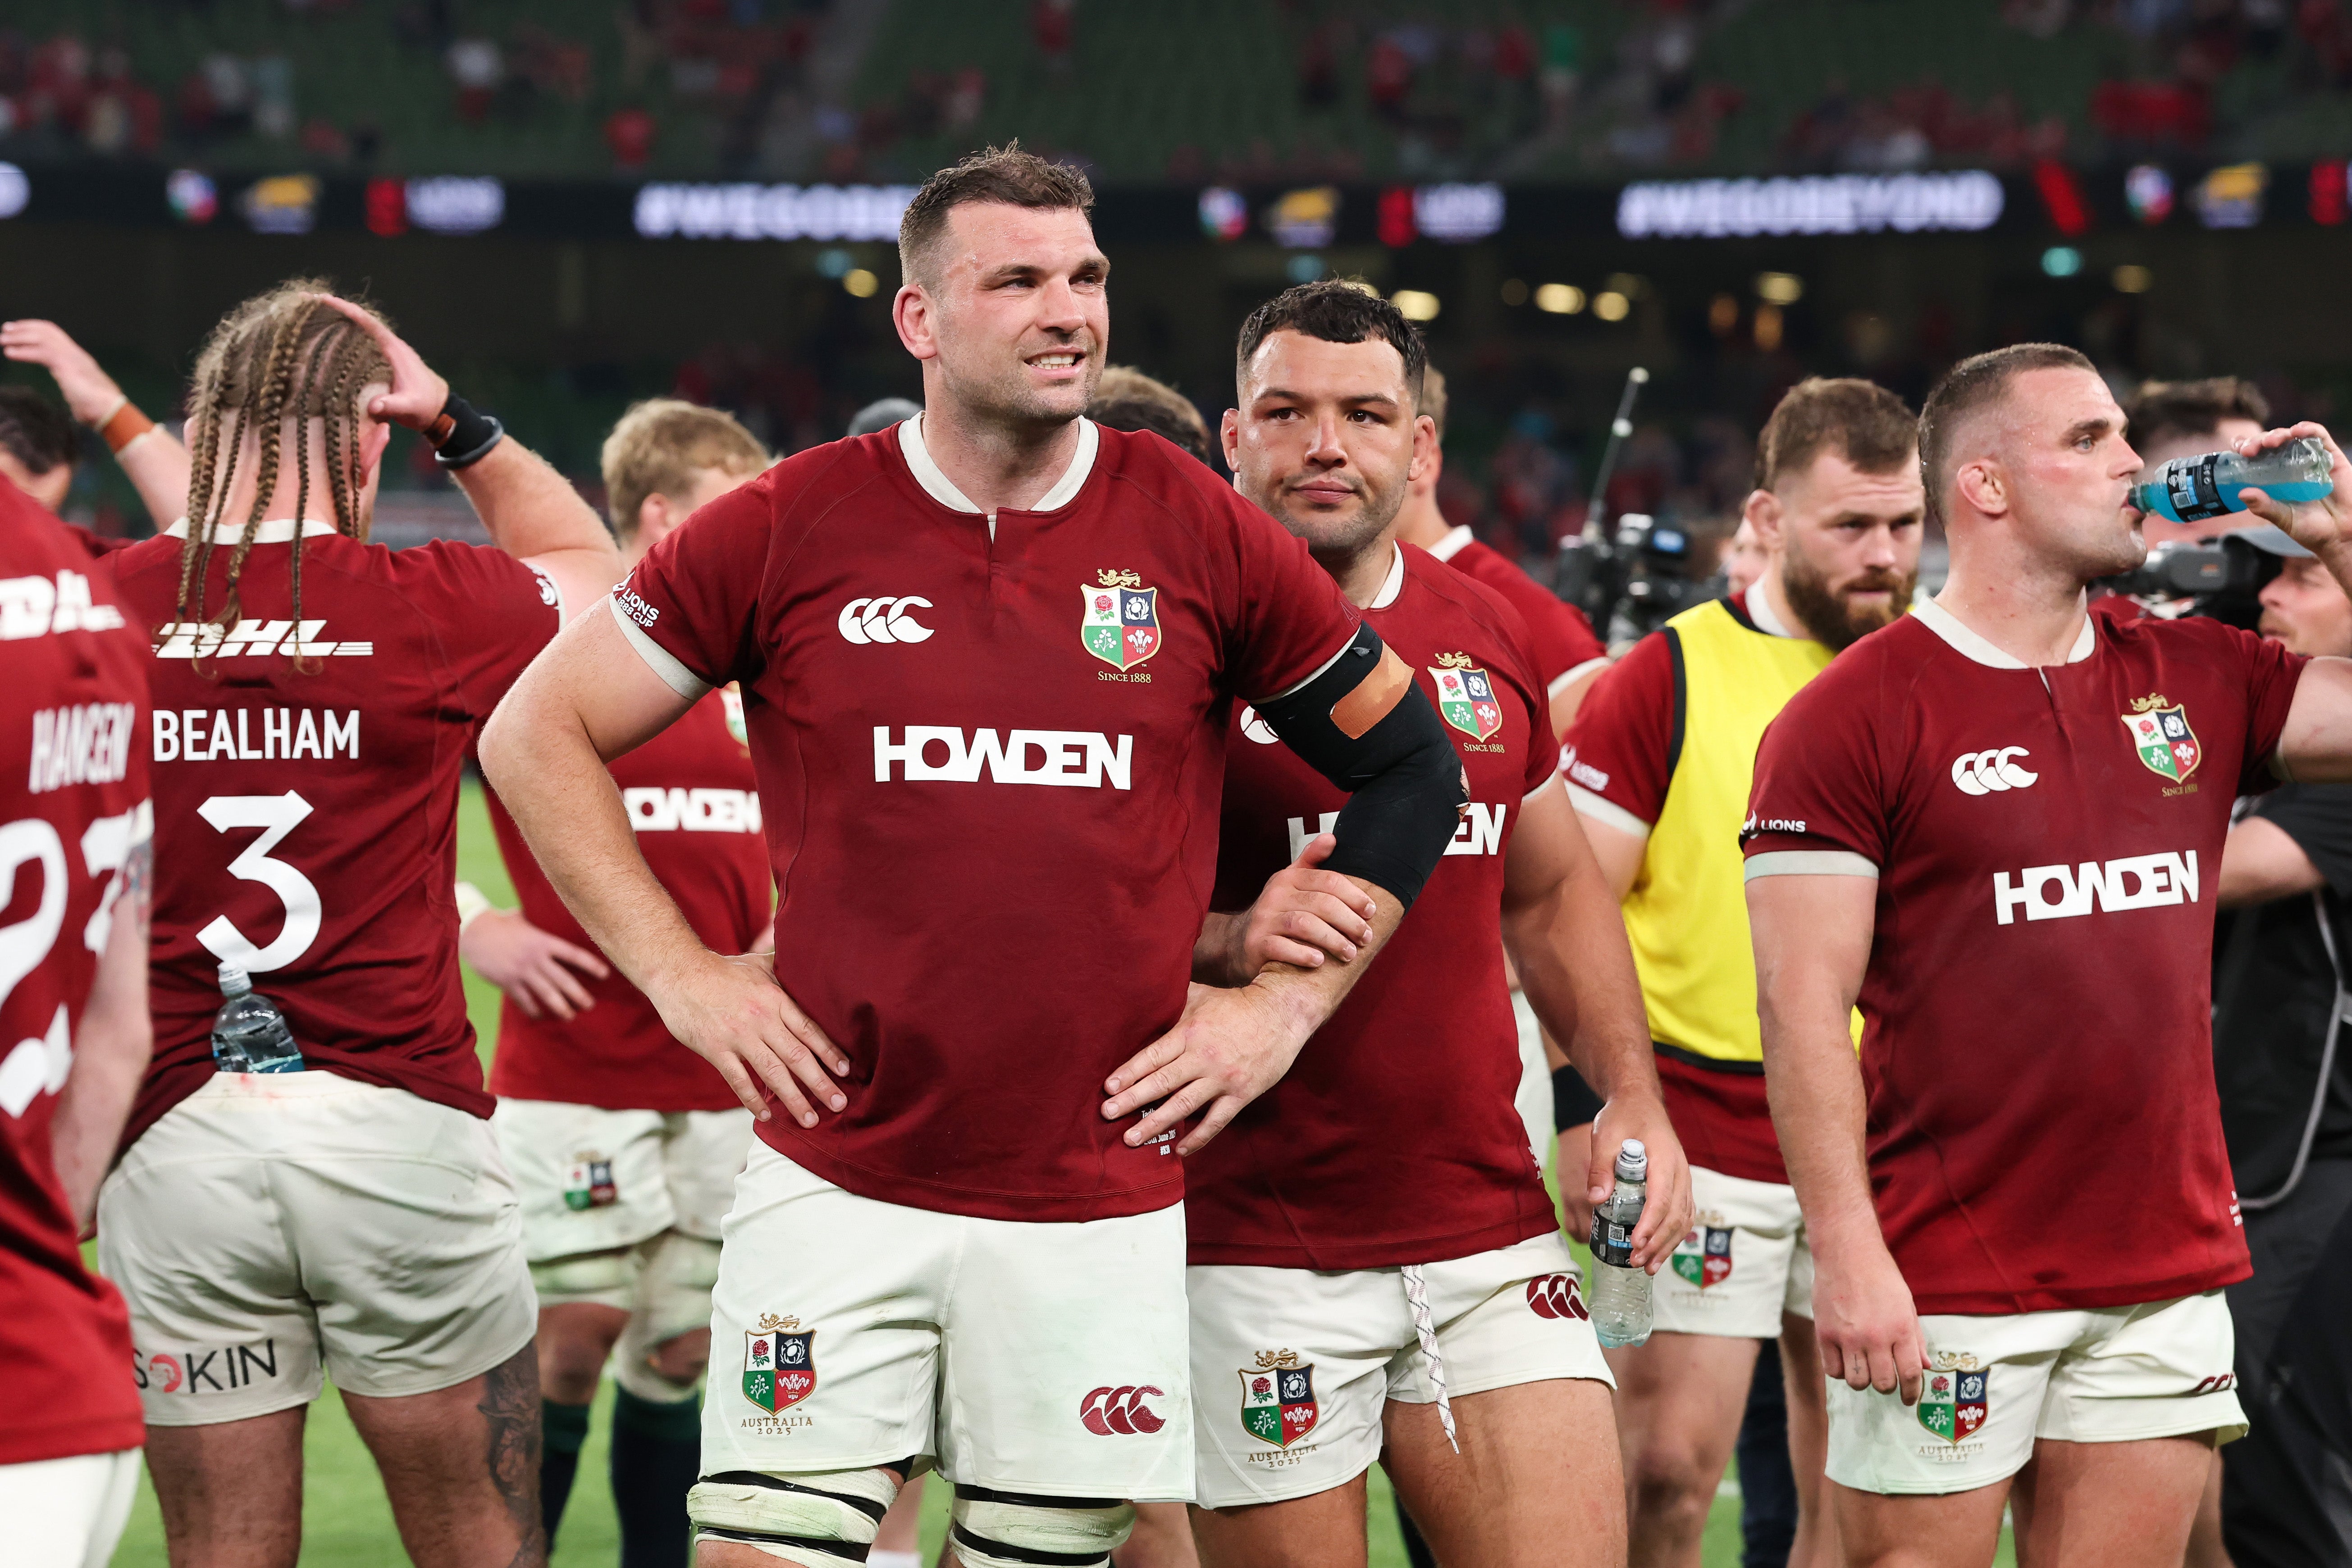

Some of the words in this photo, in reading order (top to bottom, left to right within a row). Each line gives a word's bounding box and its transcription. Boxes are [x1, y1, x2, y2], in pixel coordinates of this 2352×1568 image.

[635, 184, 918, 241] #WEGOBE
[622, 587, 660, 620] LIONS
[633, 612, 654, 627] CUP
[156, 619, 339, 658] DHL
[1130, 673, 1151, 683] 1888
[153, 708, 360, 762] BEALHAM
[28, 701, 135, 795] HANSEN
[873, 726, 1133, 790] HOWDEN
[1489, 743, 1505, 754] 1888
[1288, 802, 1506, 864] HEN
[1761, 819, 1806, 832] LIONS
[195, 790, 322, 973] 3
[1993, 850, 2199, 925] HOWDEN
[1158, 1134, 1169, 1143] June
[741, 1417, 813, 1427] AUSTRALIA
[1248, 1444, 1317, 1462] AUSTRALIA
[1919, 1443, 1983, 1454] AUSTRALIA
[1269, 1457, 1301, 1468] 2025
